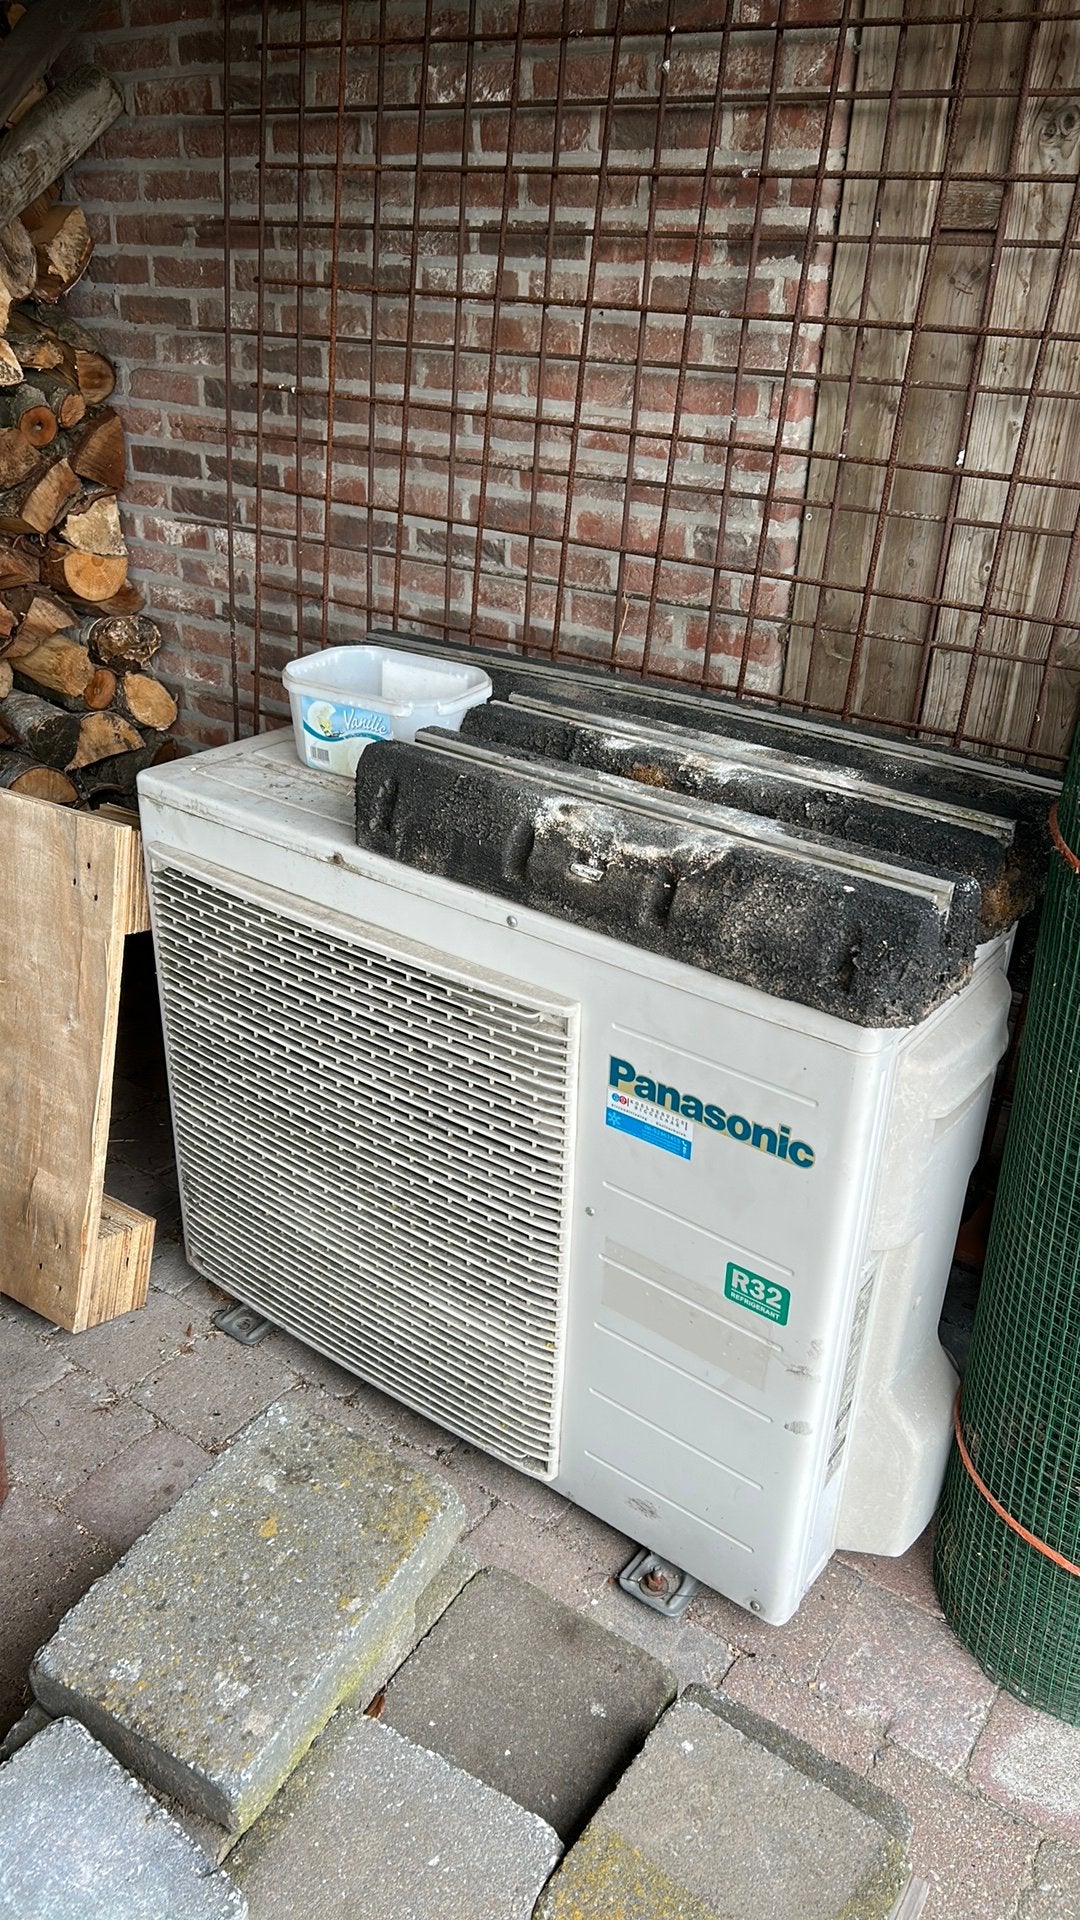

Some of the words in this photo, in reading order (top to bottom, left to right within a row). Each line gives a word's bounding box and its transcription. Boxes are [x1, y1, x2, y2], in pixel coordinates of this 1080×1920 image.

[343, 708, 389, 735] Vanille
[609, 1055, 815, 1169] Panasonic
[730, 1291, 780, 1321] REFRIGERANT
[731, 1268, 783, 1310] R32
